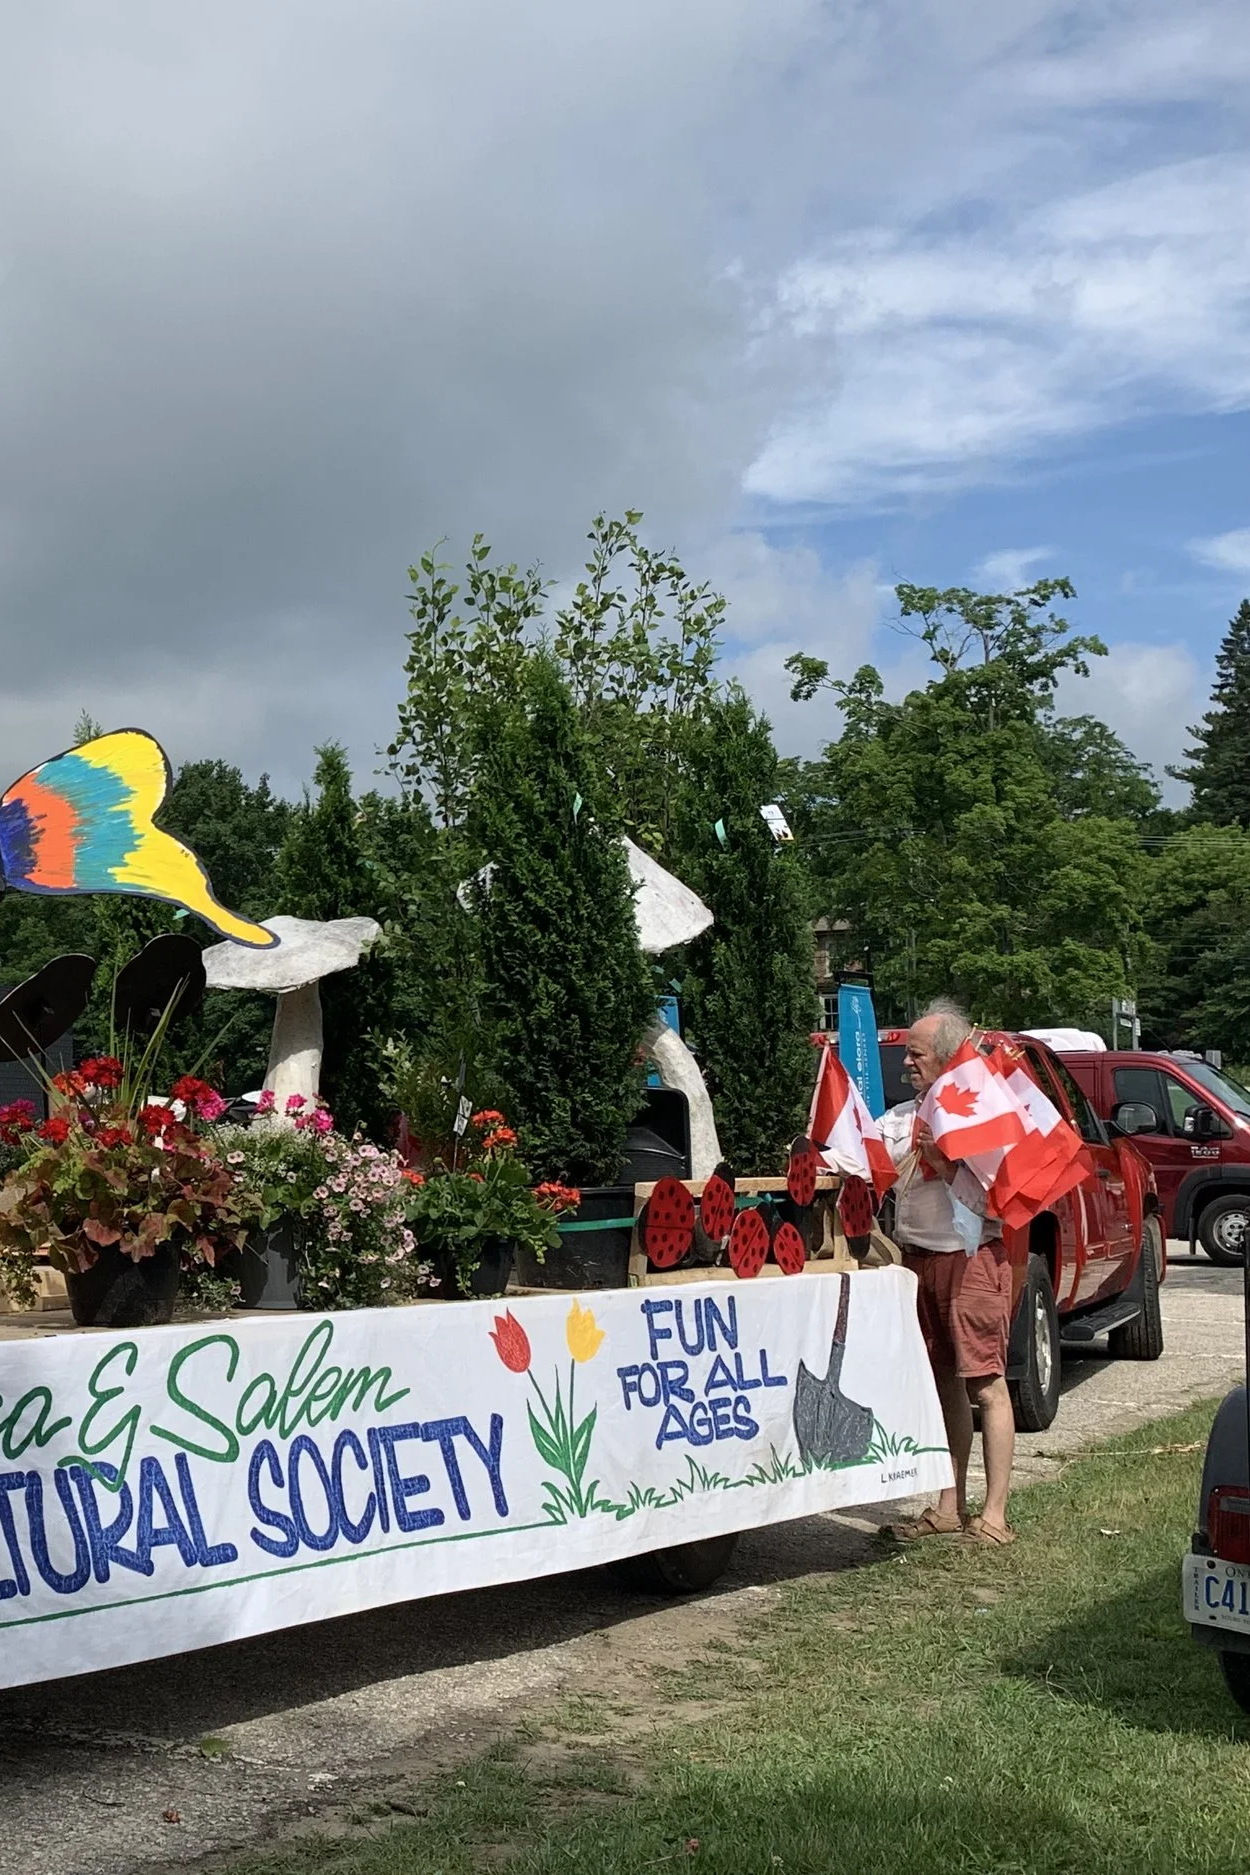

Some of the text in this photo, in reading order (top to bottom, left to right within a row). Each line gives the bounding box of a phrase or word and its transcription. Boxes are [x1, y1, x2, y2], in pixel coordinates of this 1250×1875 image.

[640, 1295, 738, 1361] FUN
[150, 1319, 411, 1463] Salem
[617, 1349, 788, 1411] FOR ALL
[655, 1395, 760, 1450] AGES
[249, 1412, 510, 1559] SOCIETY
[1205, 1575, 1249, 1616] C41
